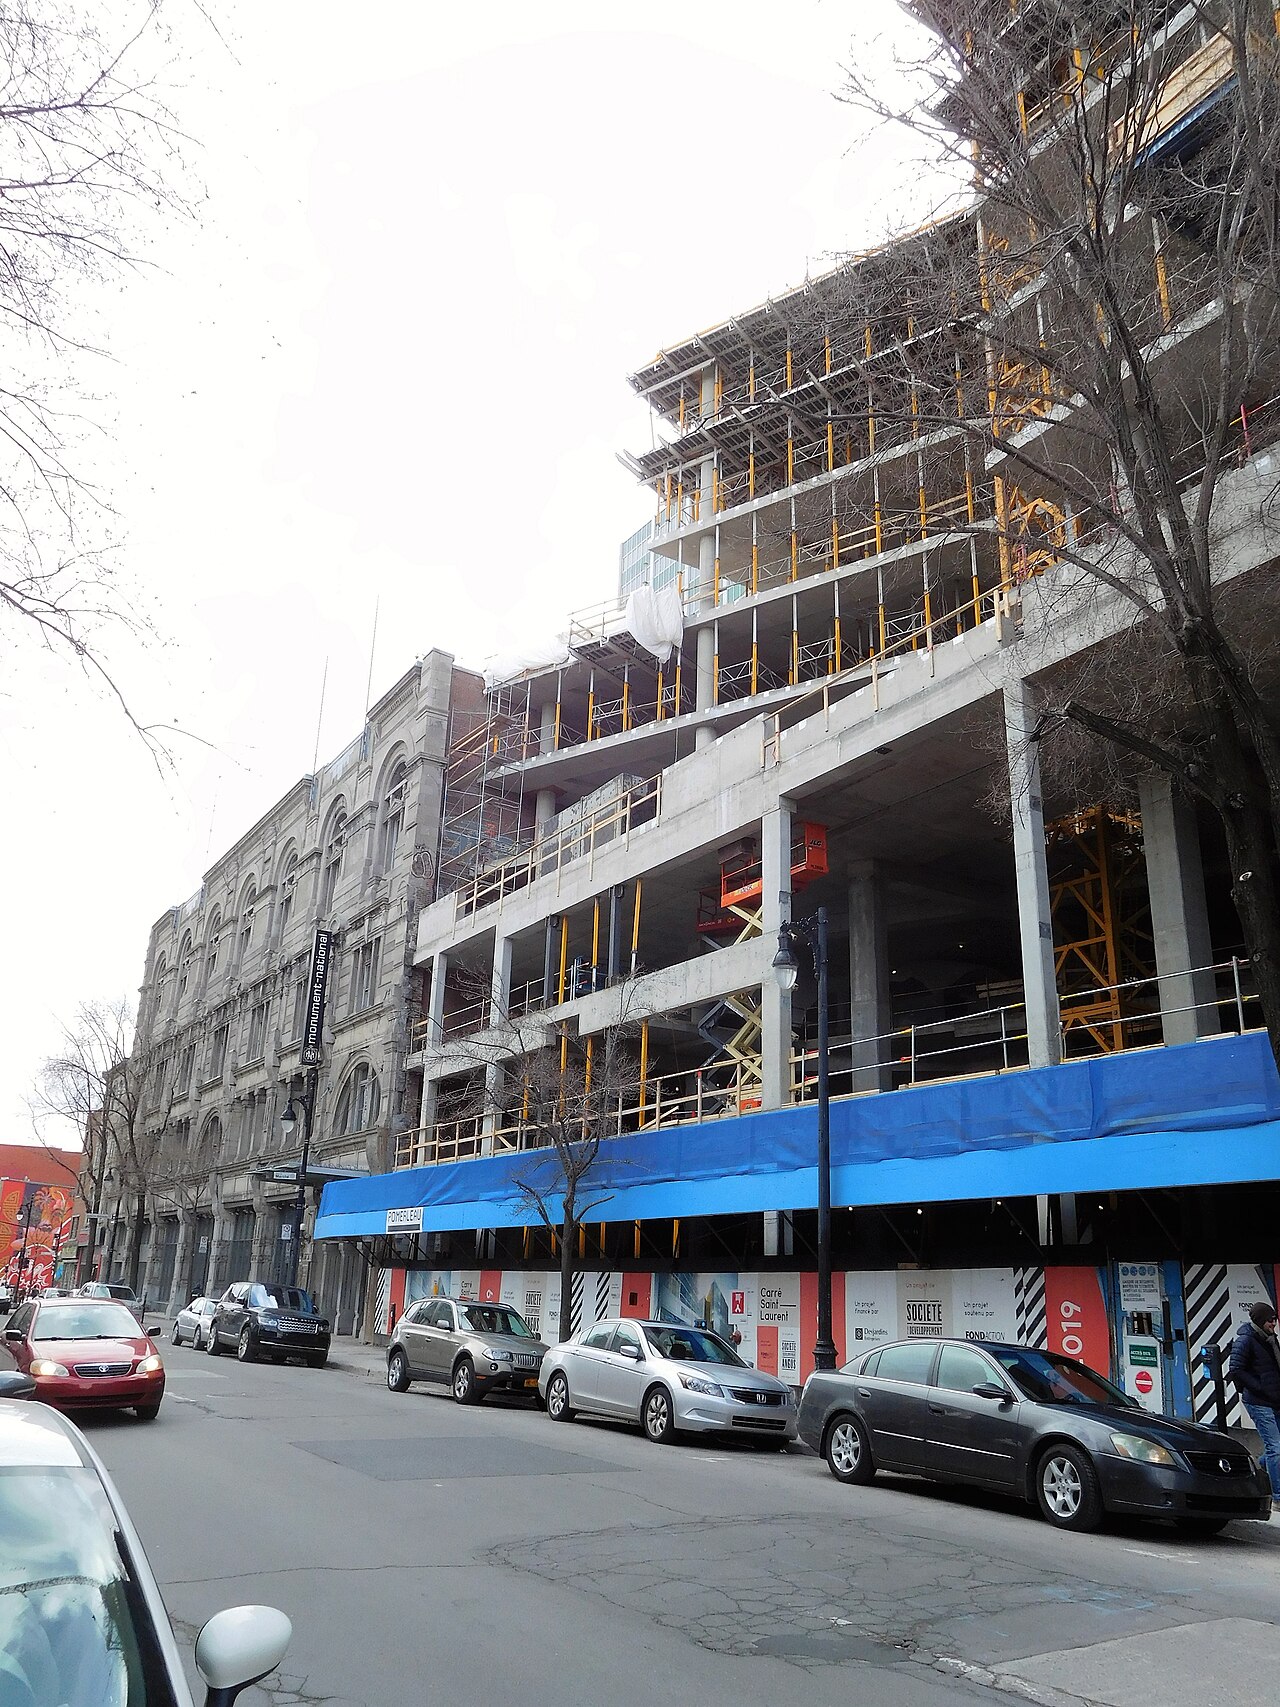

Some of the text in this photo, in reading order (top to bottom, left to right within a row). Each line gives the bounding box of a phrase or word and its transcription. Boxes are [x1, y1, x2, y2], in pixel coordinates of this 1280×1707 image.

[308, 933, 328, 1044] monument-national
[388, 1209, 422, 1222] POMERLEAU
[760, 1288, 782, 1298] Carré
[972, 1302, 989, 1310] projet
[760, 1311, 788, 1321] Laurent
[864, 1328, 889, 1337] Desjardins
[965, 1331, 1006, 1341] FONDACTION
[1060, 1301, 1084, 1365] 019
